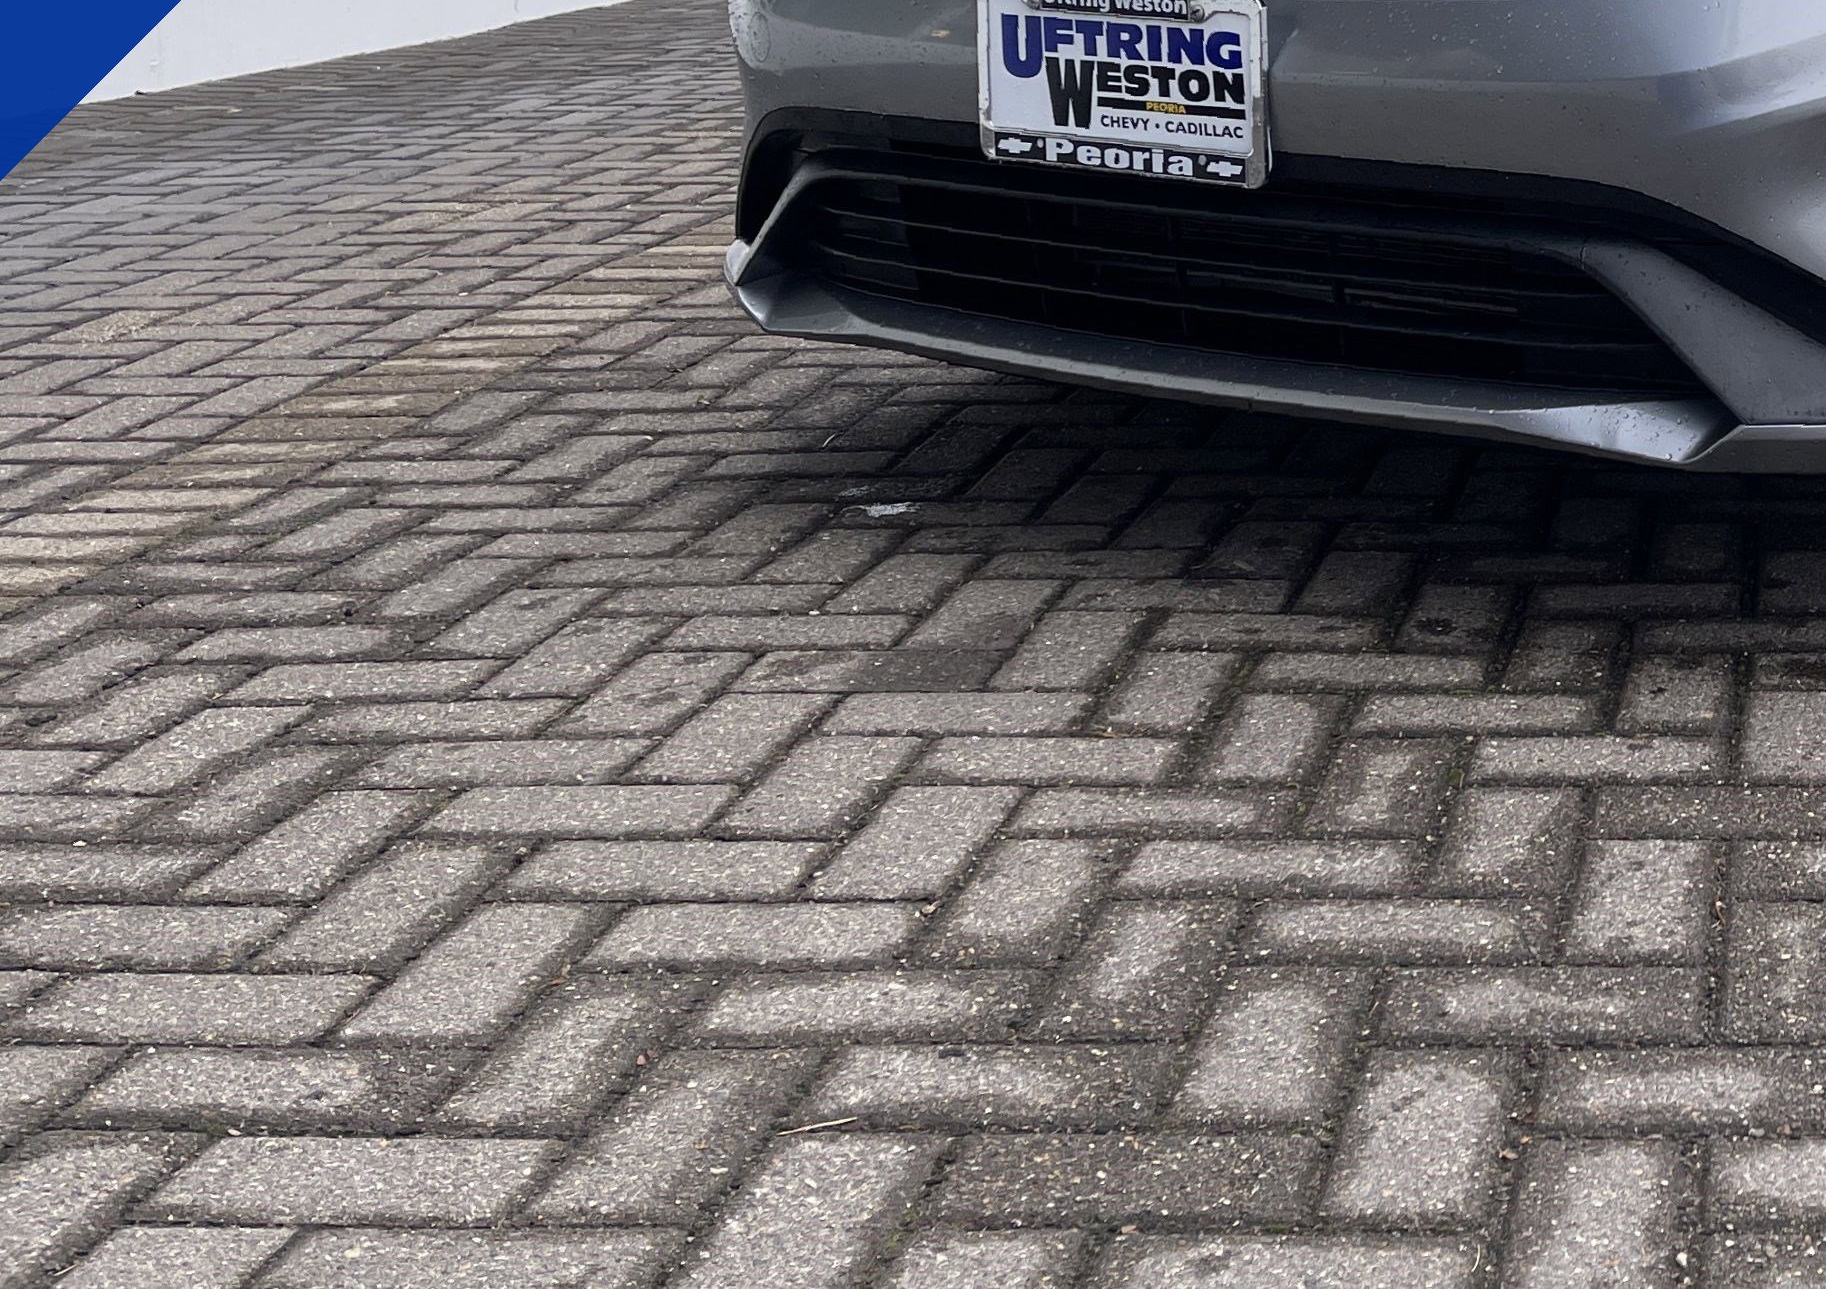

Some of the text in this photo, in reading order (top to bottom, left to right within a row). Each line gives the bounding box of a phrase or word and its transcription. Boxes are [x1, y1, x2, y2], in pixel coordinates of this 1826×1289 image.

[1001, 12, 1243, 79] UFTRING
[1044, 56, 1246, 129] WESTON
[1145, 101, 1187, 115] PEORIA
[1100, 114, 1244, 139] CHEVY CADILLAC
[1045, 138, 1194, 177] Peoria
